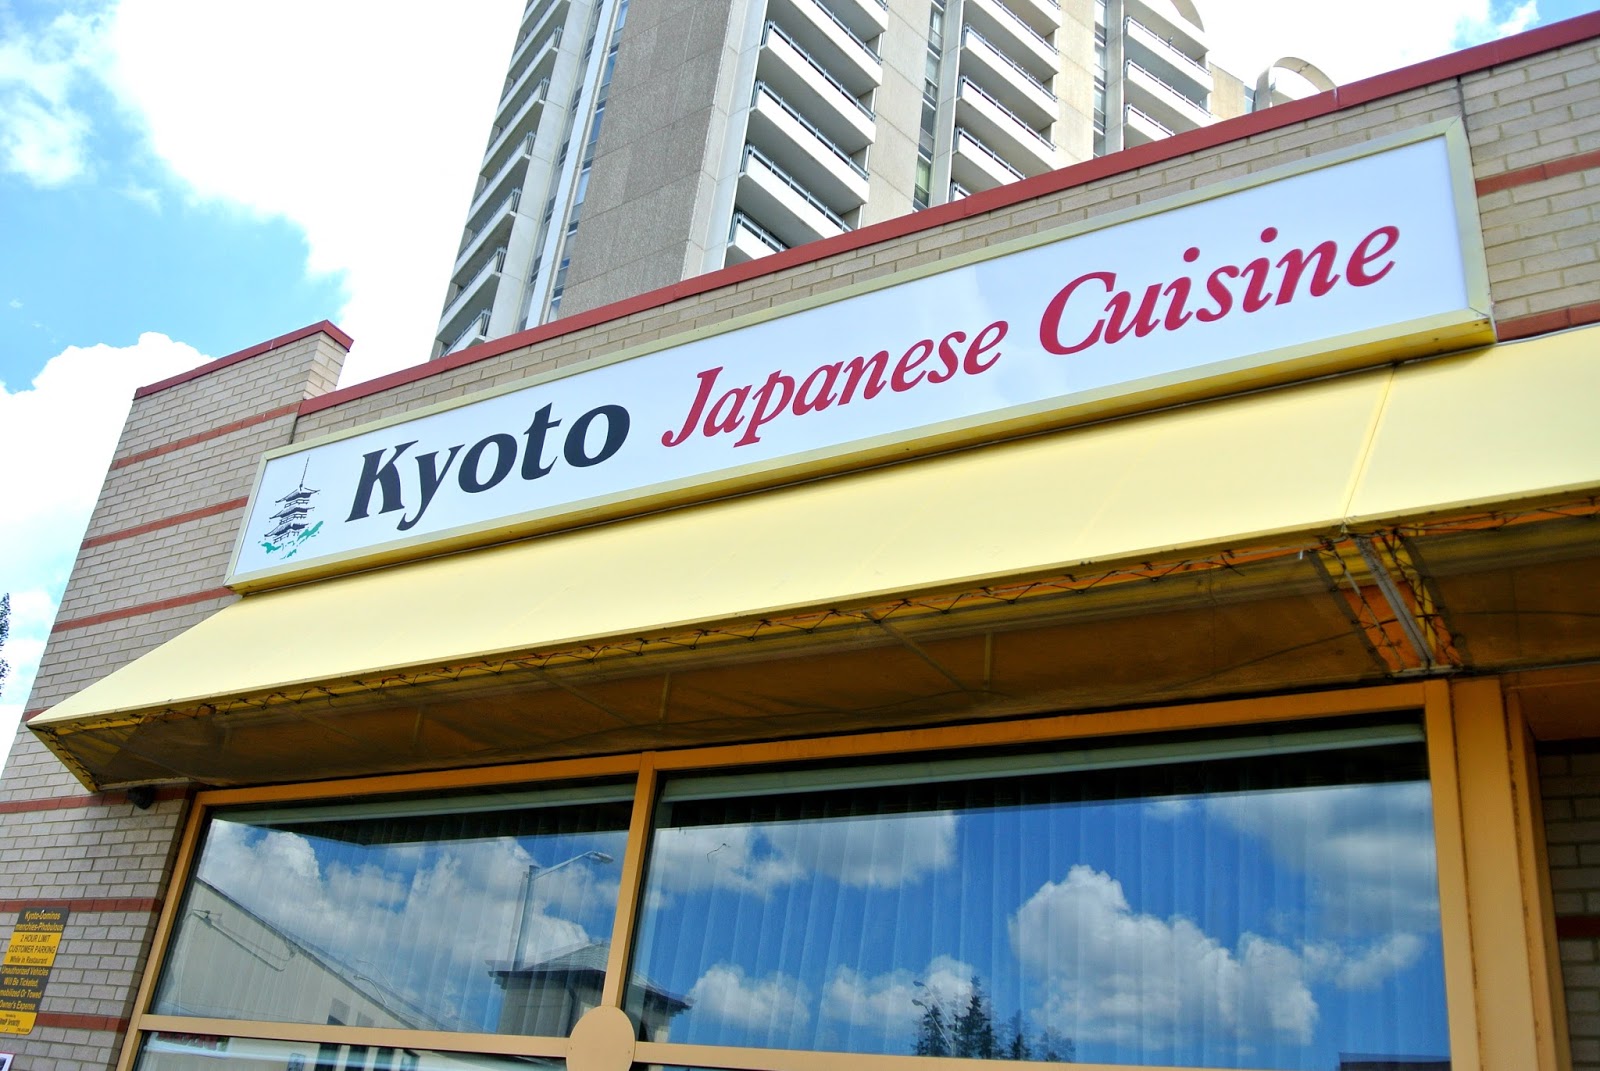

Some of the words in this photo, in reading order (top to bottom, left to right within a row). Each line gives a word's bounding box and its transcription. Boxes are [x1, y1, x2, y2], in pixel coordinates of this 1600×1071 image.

[345, 402, 630, 531] Kyoto
[661, 321, 1008, 447] Japanese
[1039, 226, 1399, 356] Cuisine
[24, 934, 39, 942] HOUR
[38, 934, 51, 942] LIMIT
[9, 944, 34, 953] CUSTOMER
[34, 945, 56, 954] PARKING
[26, 956, 48, 964] Restaurant
[1, 966, 30, 975] Unauthorized
[30, 967, 49, 976] Vehicles
[4, 977, 13, 985] Will
[12, 977, 19, 986] Be
[20, 989, 27, 997] Or
[27, 990, 43, 999] Towed
[16, 1000, 36, 1010] Expense
